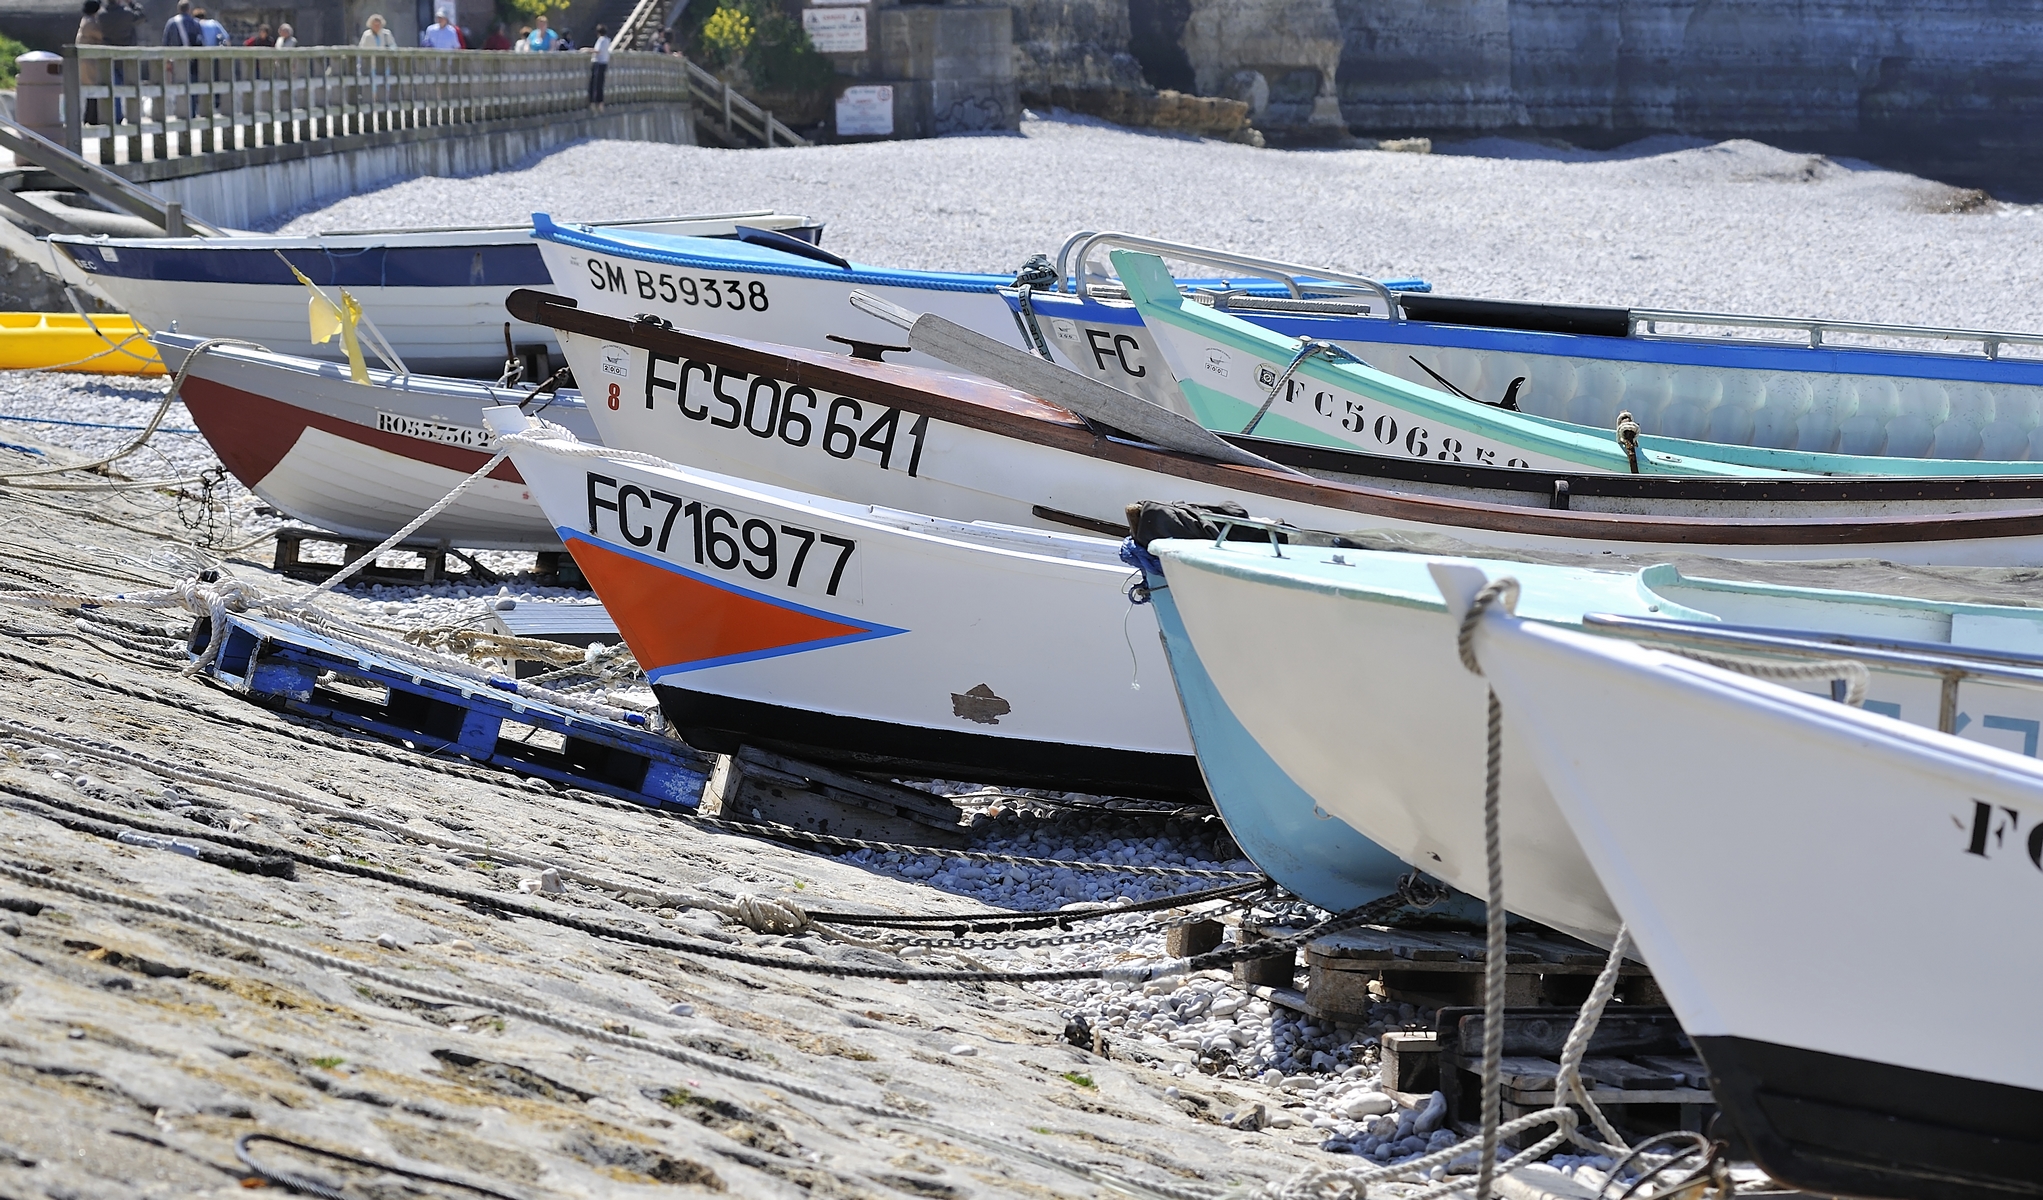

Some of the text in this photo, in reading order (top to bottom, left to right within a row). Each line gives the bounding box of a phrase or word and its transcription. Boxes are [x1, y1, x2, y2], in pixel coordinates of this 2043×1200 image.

[587, 258, 769, 312] SM B59338
[1084, 328, 1146, 378] FC
[607, 382, 621, 411] 8
[586, 471, 856, 596] FC716977
